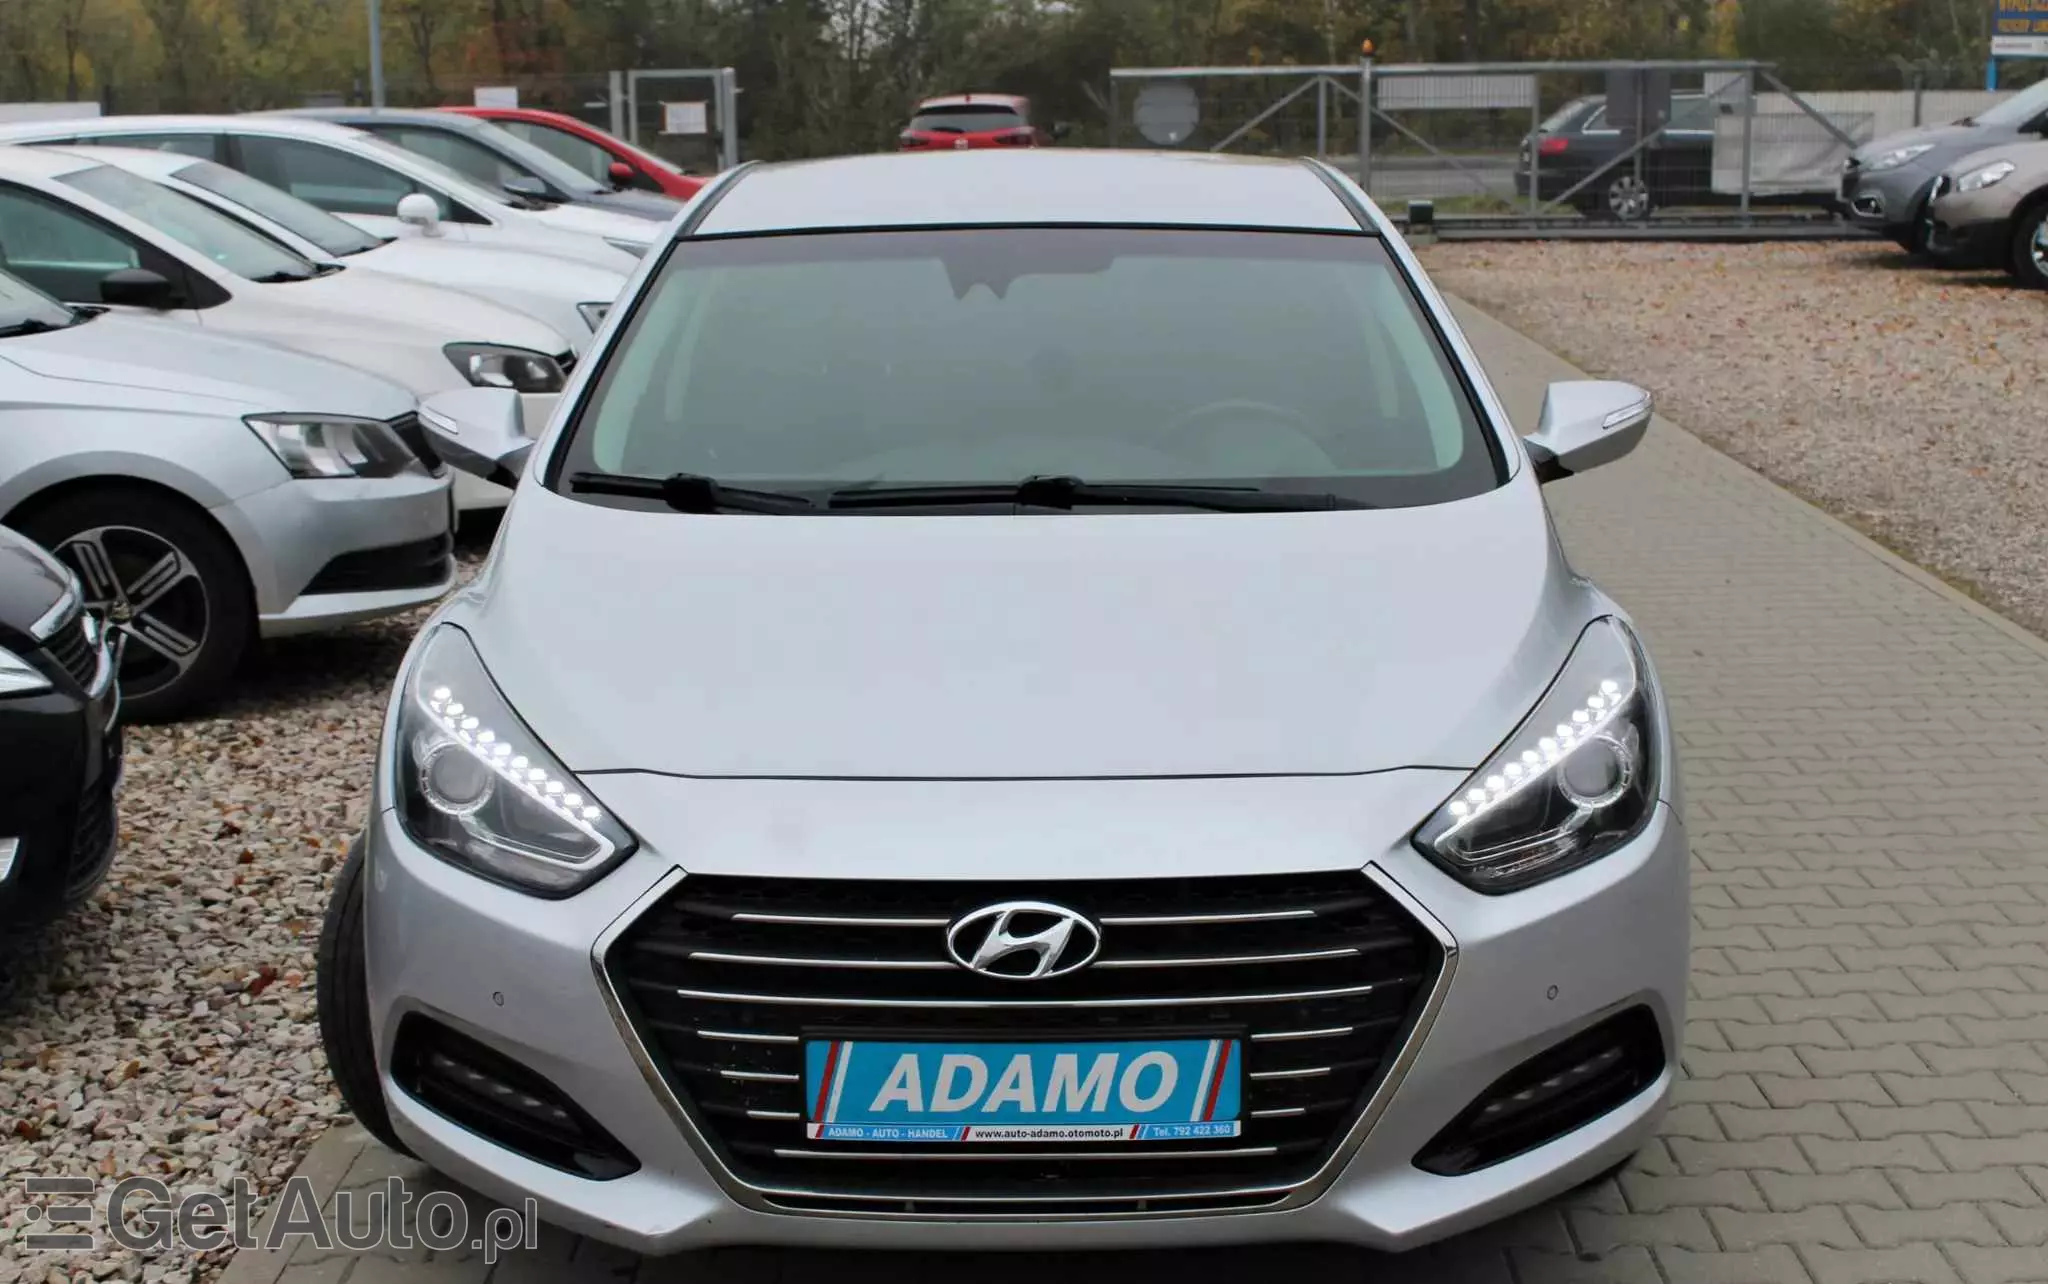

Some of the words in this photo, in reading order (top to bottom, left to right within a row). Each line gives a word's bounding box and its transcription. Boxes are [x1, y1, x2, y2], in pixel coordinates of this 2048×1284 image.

[868, 1050, 1180, 1114] ADAMO
[827, 1127, 864, 1138] ADAMO
[871, 1128, 900, 1138] AUTO
[907, 1128, 949, 1139] HANDEL
[974, 1127, 1124, 1139] www.auto-adamo.otomoto.pl
[1152, 1126, 1172, 1137] Tel.
[1173, 1126, 1191, 1137] 792
[1193, 1125, 1211, 1136] 422
